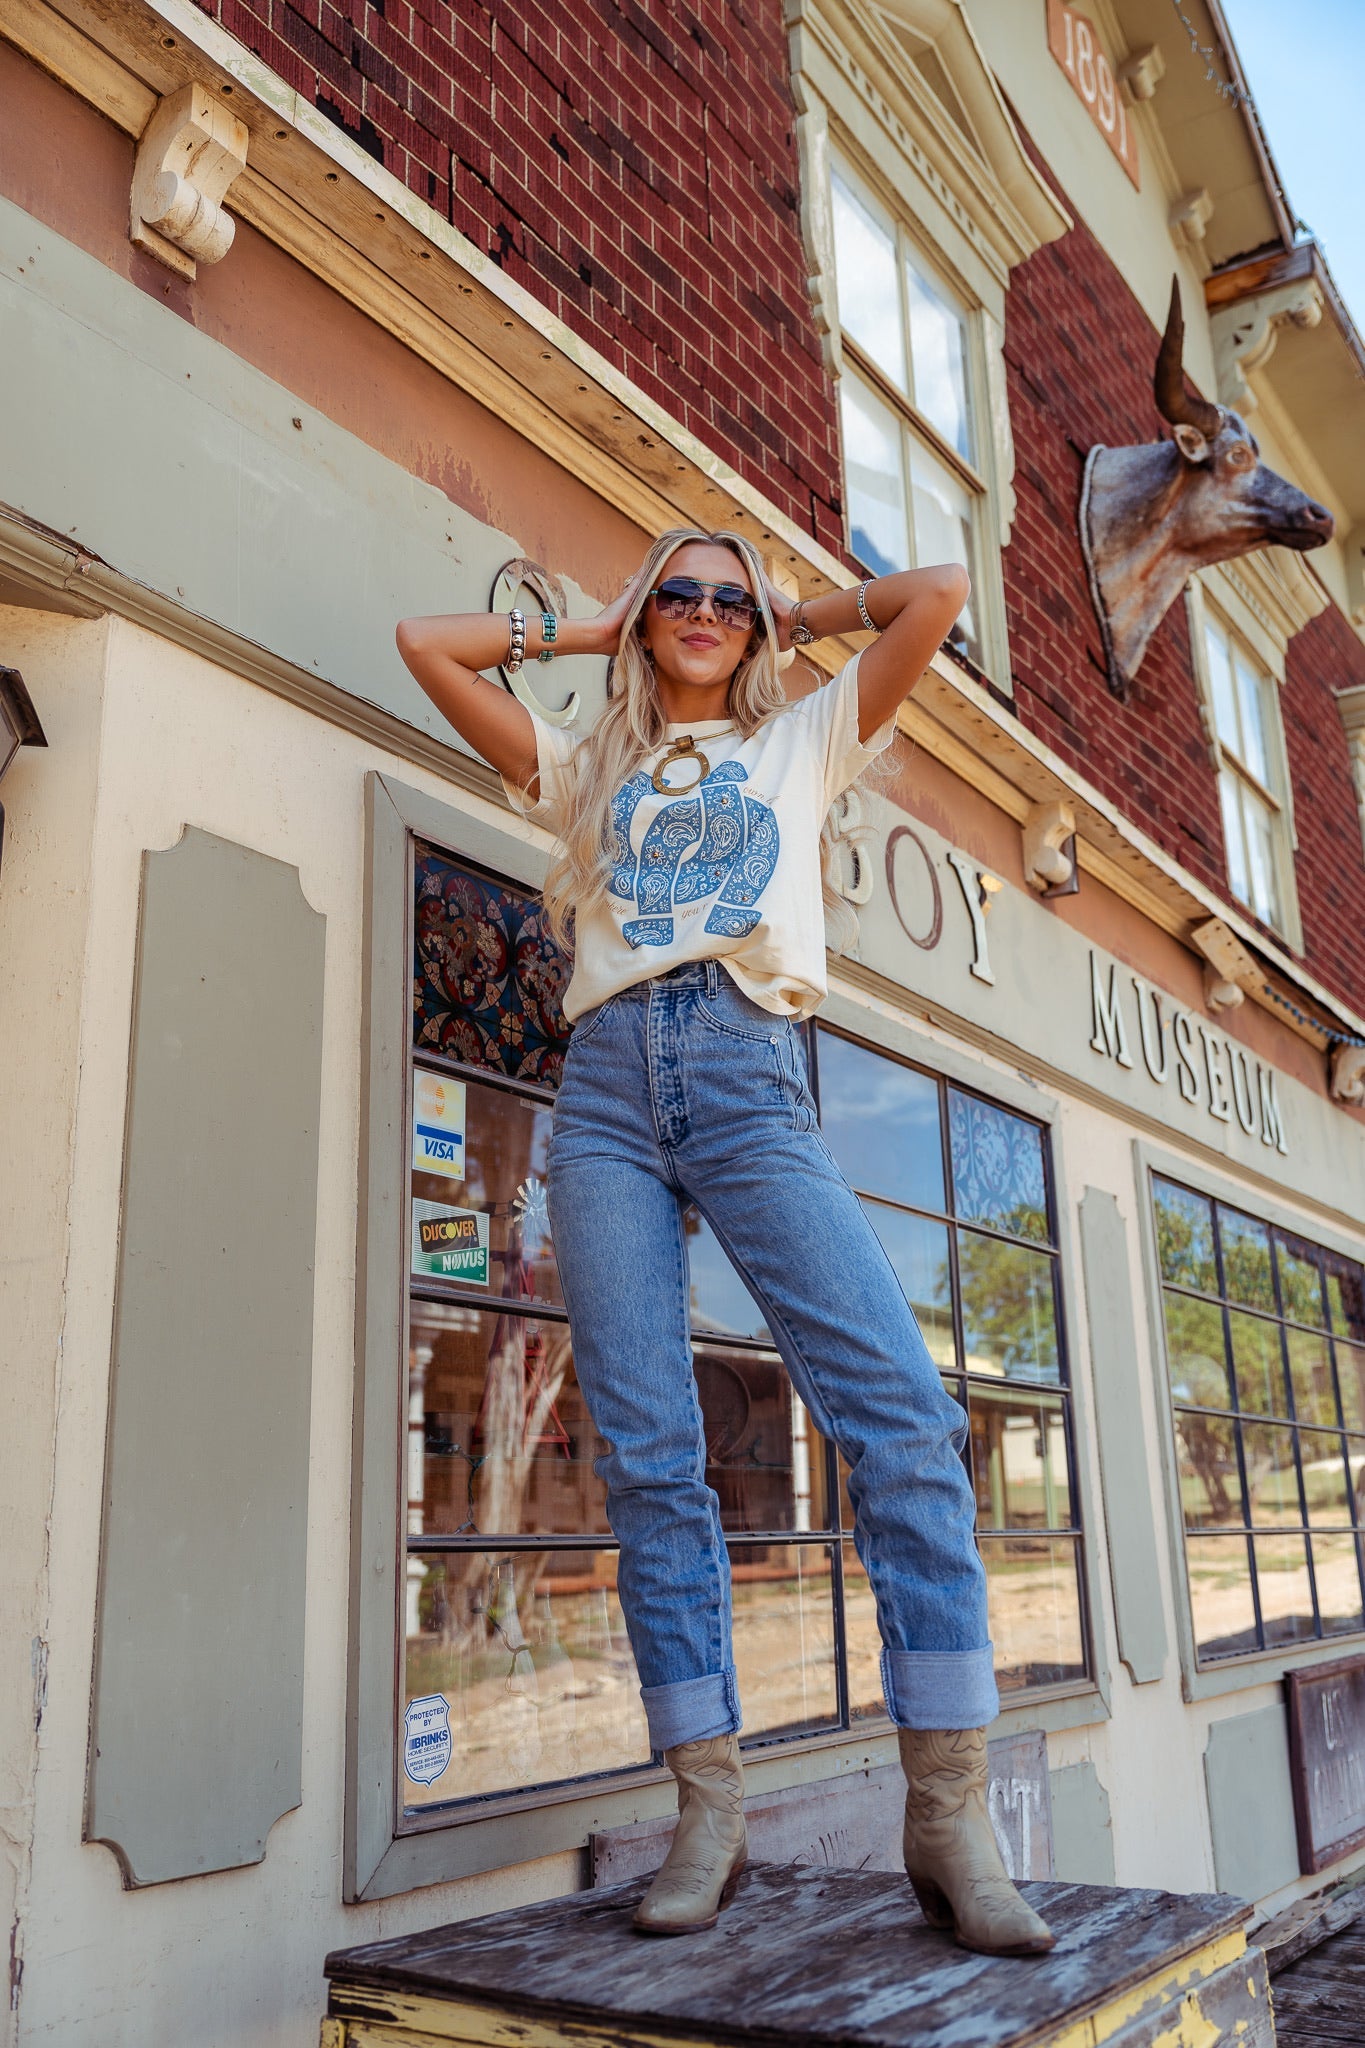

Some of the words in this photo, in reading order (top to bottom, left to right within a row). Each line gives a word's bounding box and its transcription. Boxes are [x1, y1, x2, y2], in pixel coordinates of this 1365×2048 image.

[1063, 12, 1128, 160] 1891
[1089, 950, 1289, 1156] MUSEUM
[424, 1138, 454, 1161] VISA
[422, 1220, 476, 1242] DISCOVER
[442, 1251, 484, 1271] NOVUS
[410, 1707, 444, 1721] PROTECTED
[408, 1748, 423, 1757] HOME
[423, 1742, 448, 1752] SECURITY
[410, 1730, 448, 1750] BRINKS
